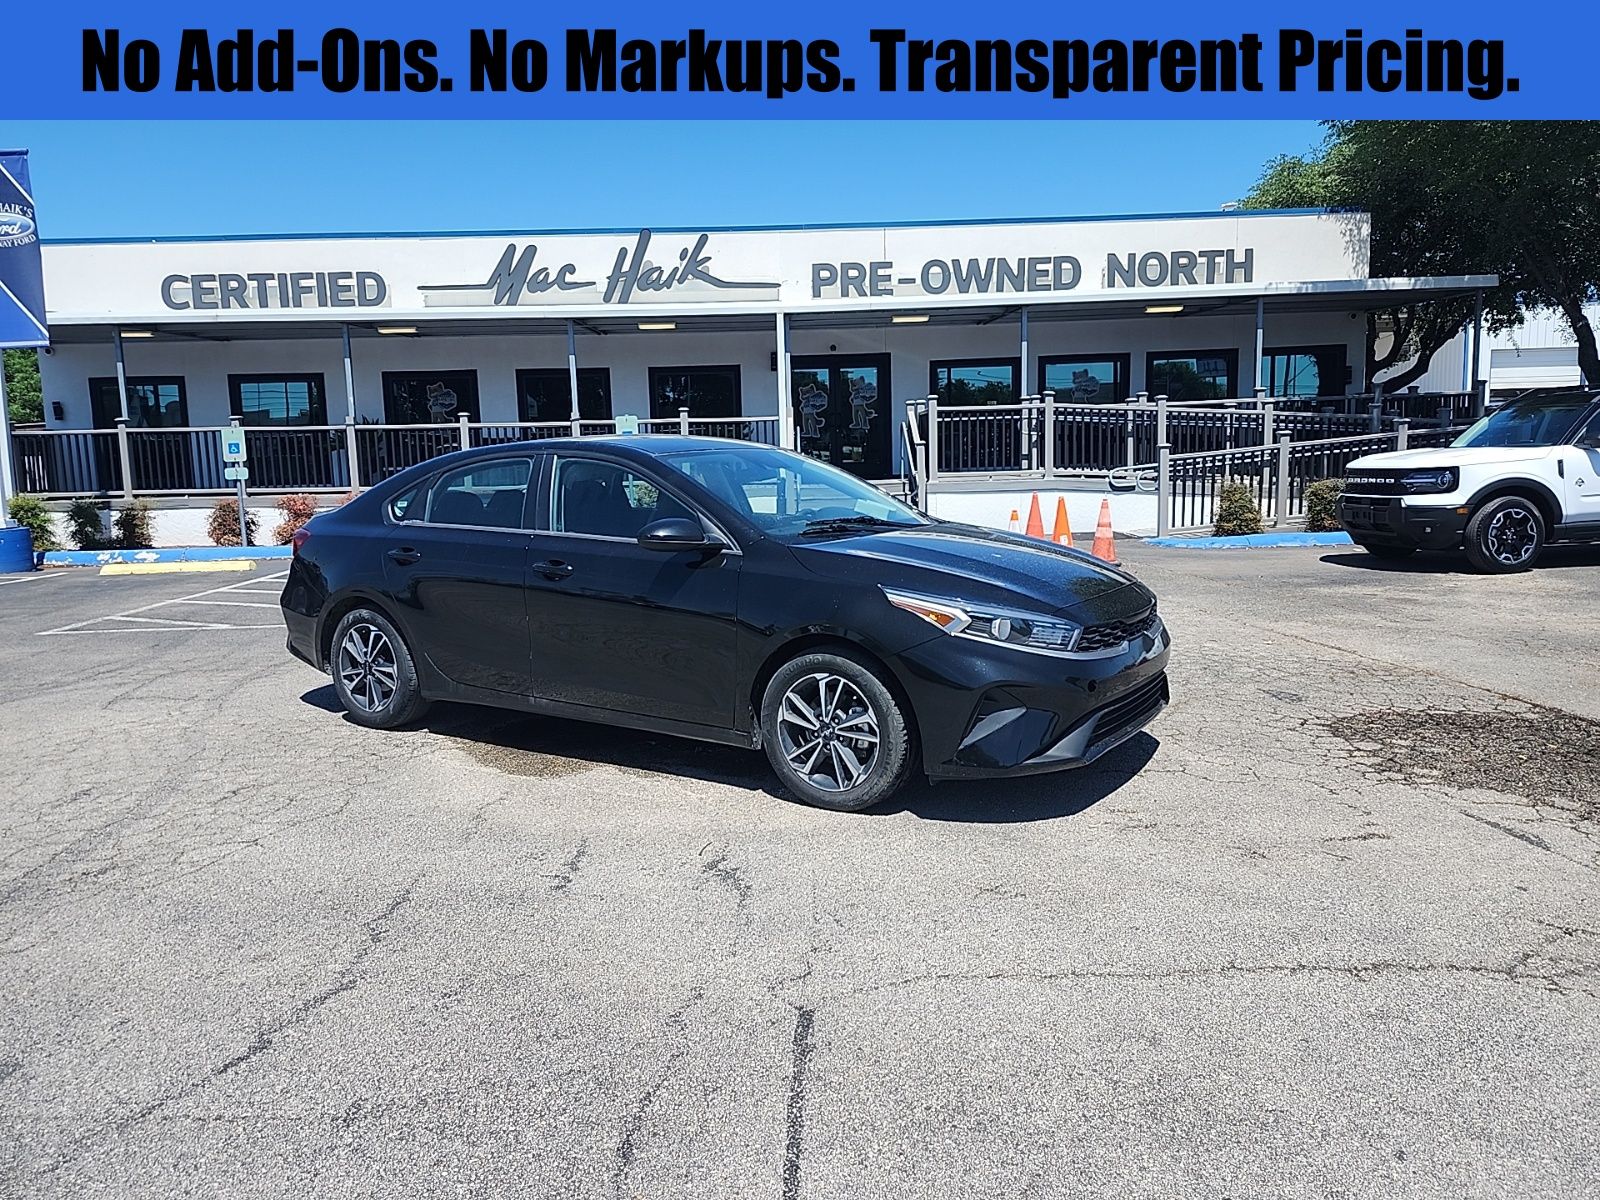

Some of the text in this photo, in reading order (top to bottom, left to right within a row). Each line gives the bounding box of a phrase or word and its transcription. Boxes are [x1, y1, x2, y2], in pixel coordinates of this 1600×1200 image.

[0, 221, 21, 235] rd
[0, 234, 37, 247] AY FORD
[161, 229, 1254, 309] CERTIFIED Mac Haik PRE-OWNED NORTH
